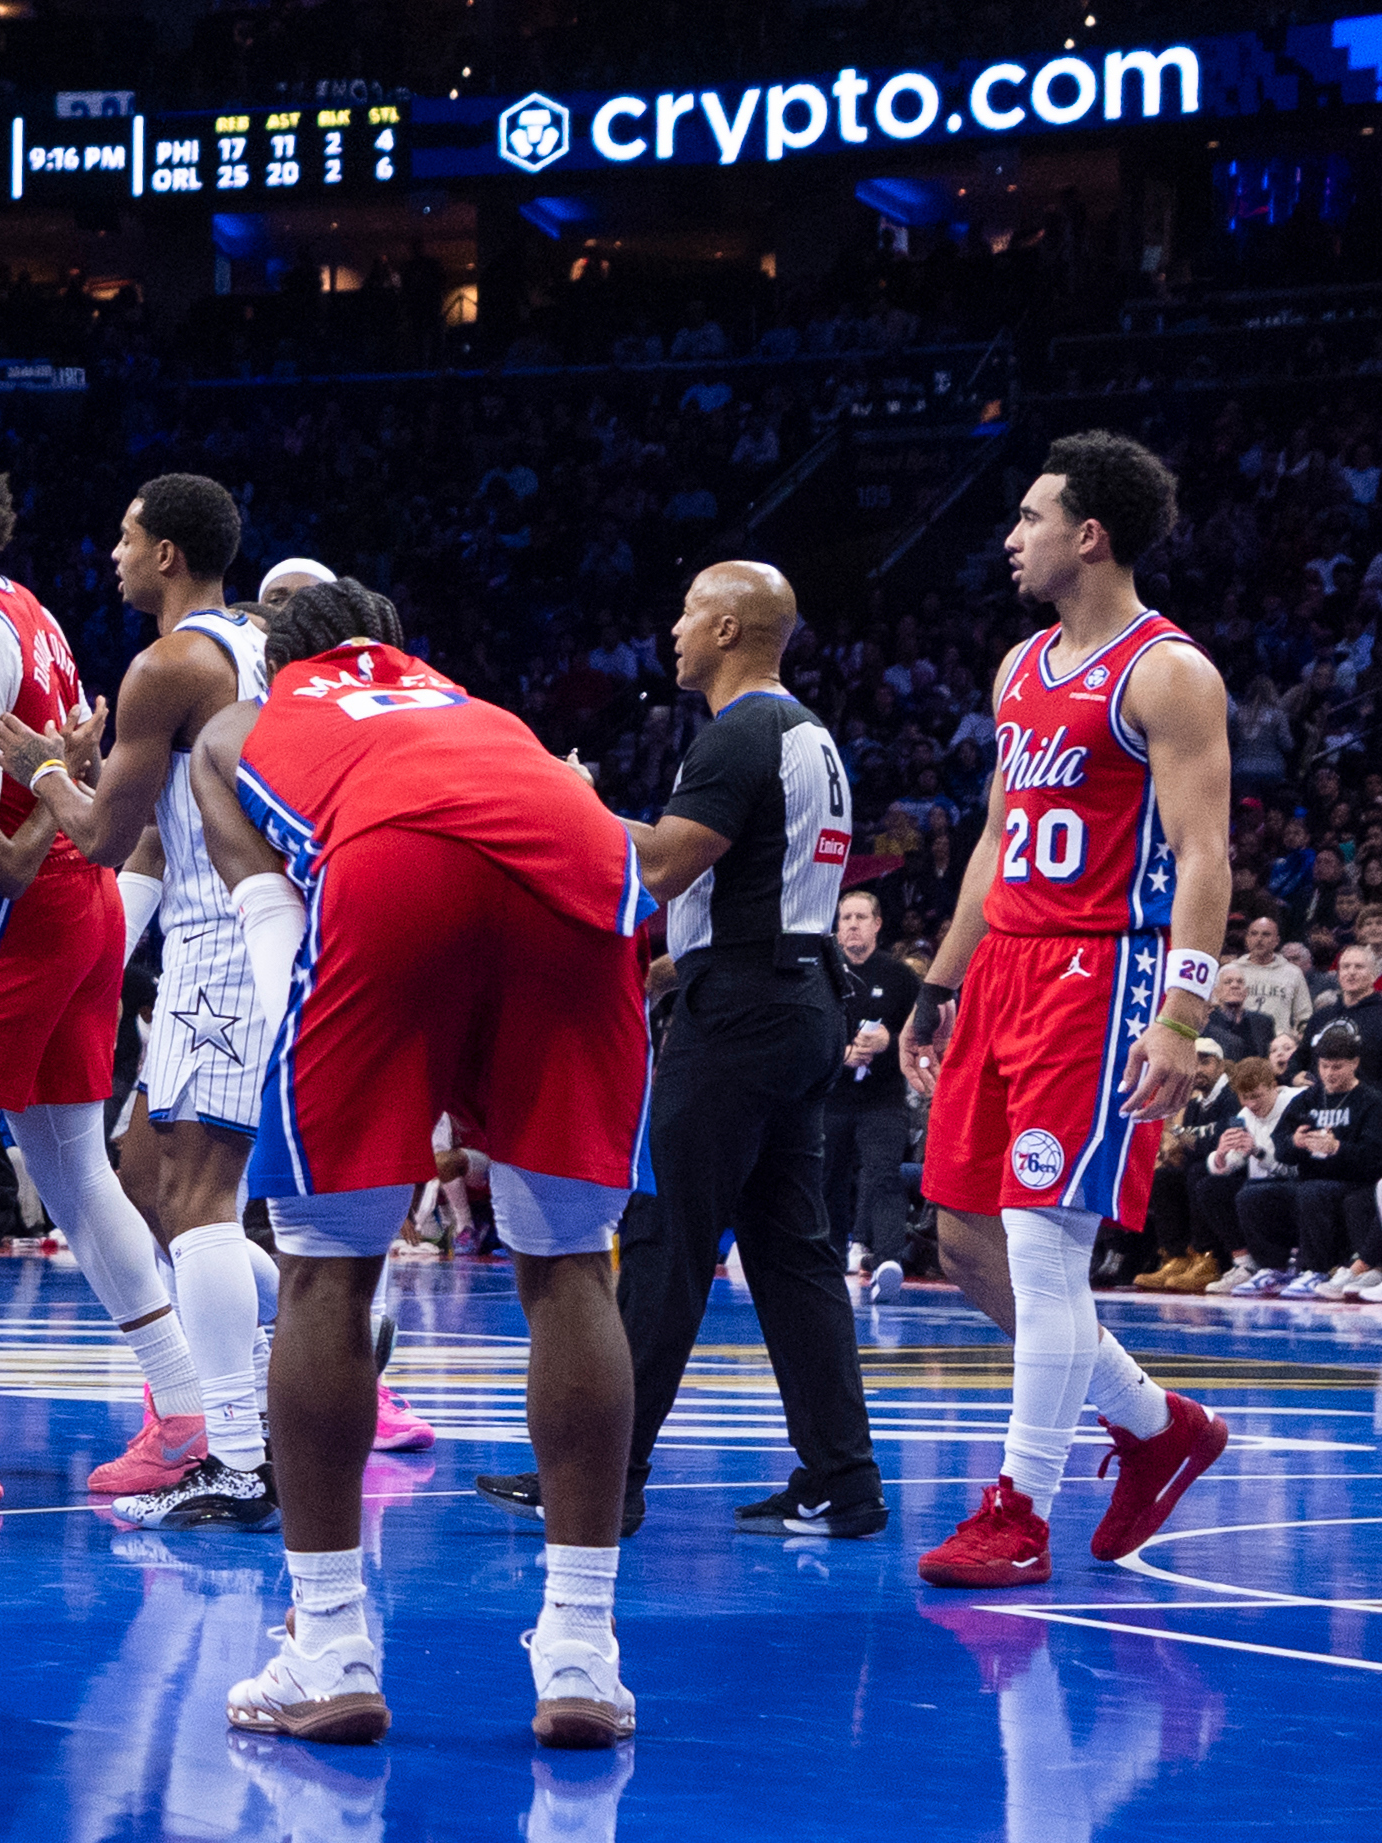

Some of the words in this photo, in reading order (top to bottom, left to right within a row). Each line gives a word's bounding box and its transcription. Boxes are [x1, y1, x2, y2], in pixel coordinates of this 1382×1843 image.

[216, 115, 250, 133] REB
[266, 112, 301, 131] AST
[318, 109, 351, 128] BLK
[369, 106, 400, 125] STL
[591, 46, 1201, 165] crypto.com
[29, 147, 79, 171] 9:16
[84, 146, 125, 171] PM
[156, 139, 199, 165] PHI
[219, 137, 246, 162] 17
[271, 134, 295, 159] 11
[324, 131, 342, 156] 2
[374, 128, 394, 152] 4
[151, 167, 203, 192] ORL
[217, 164, 249, 189] 25
[266, 161, 300, 186] 20
[324, 158, 342, 184] 2
[376, 156, 393, 181] 6
[995, 721, 1090, 792] Phila
[821, 744, 844, 818] 8
[1003, 808, 1088, 882] 20
[1179, 959, 1209, 985] 20
[1015, 1150, 1058, 1174] 76ers
